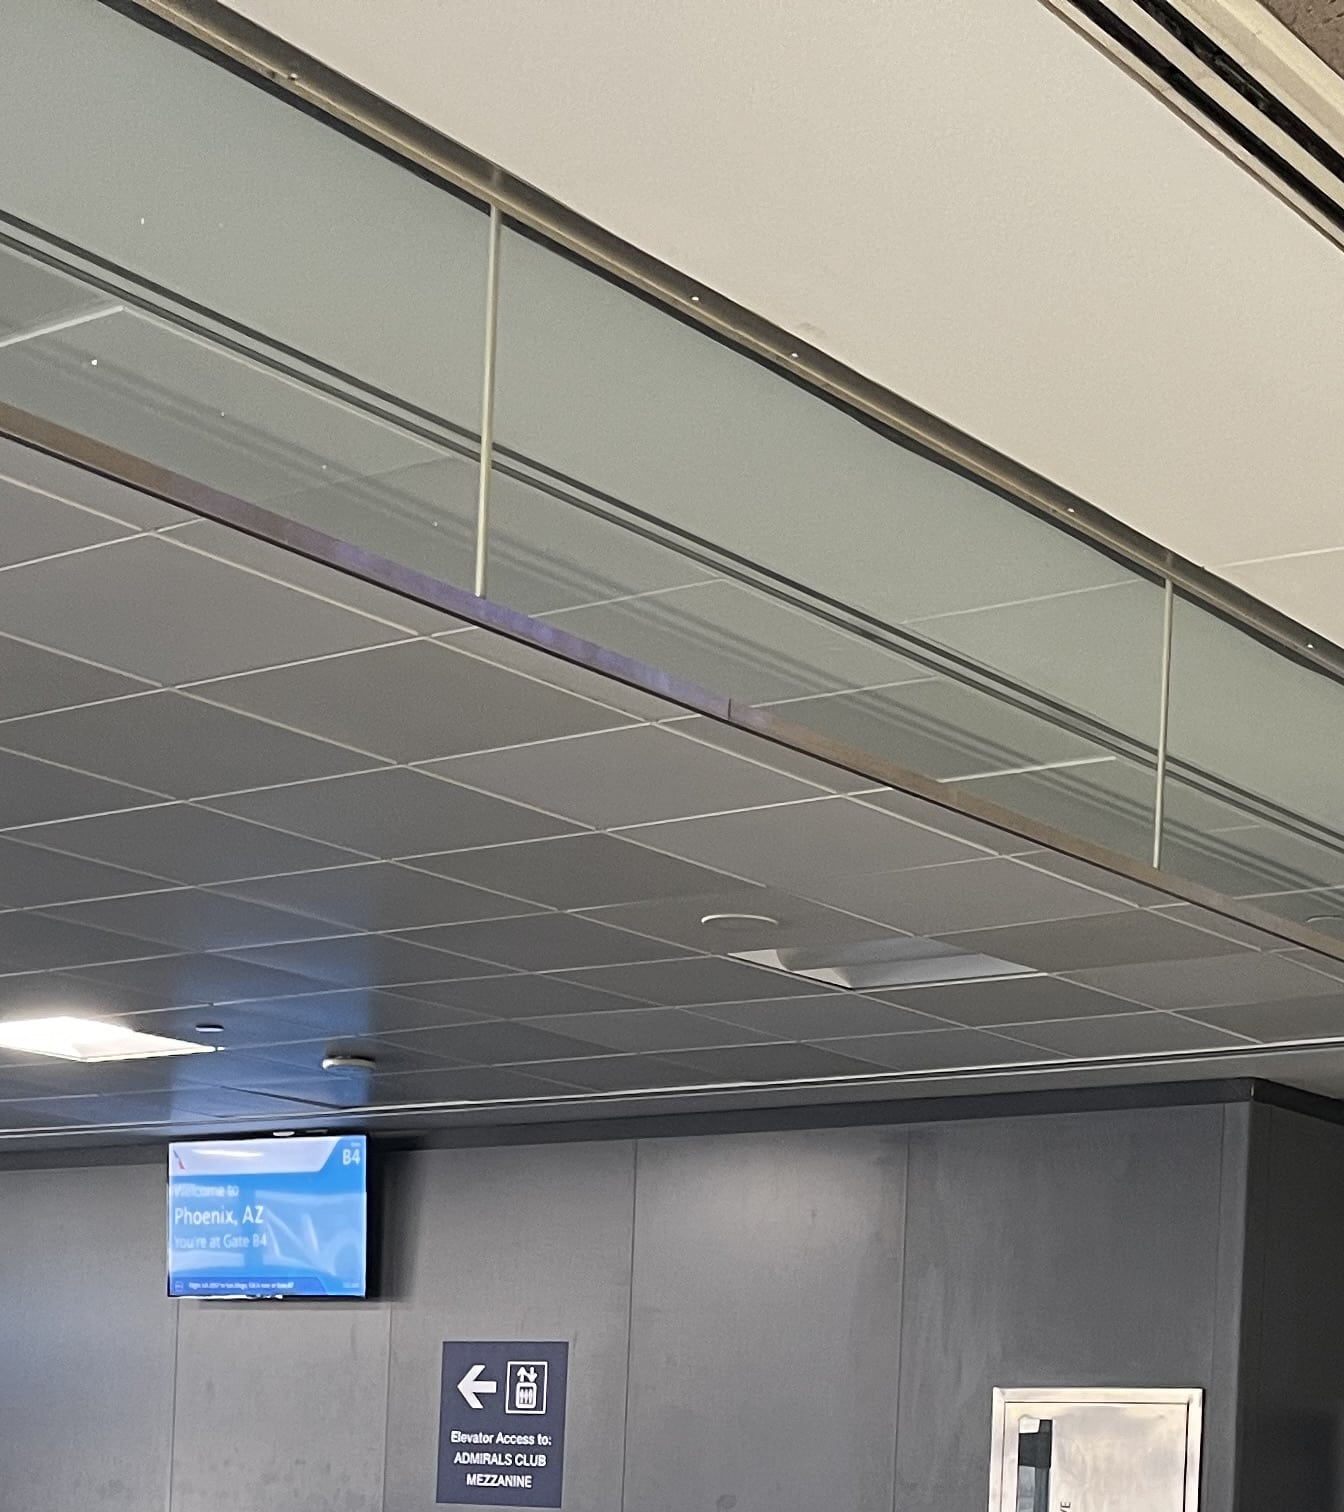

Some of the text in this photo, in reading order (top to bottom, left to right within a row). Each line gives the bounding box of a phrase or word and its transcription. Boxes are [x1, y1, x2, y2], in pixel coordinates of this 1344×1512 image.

[342, 1148, 361, 1165] B4
[175, 1205, 264, 1226] Phoenix, AZ
[223, 1233, 250, 1248] Gate
[252, 1233, 267, 1248] B4
[450, 1430, 552, 1446] Elevator Access to:
[453, 1452, 547, 1467] ADMIRALS CLUB
[466, 1473, 533, 1488] MEZZANINE
